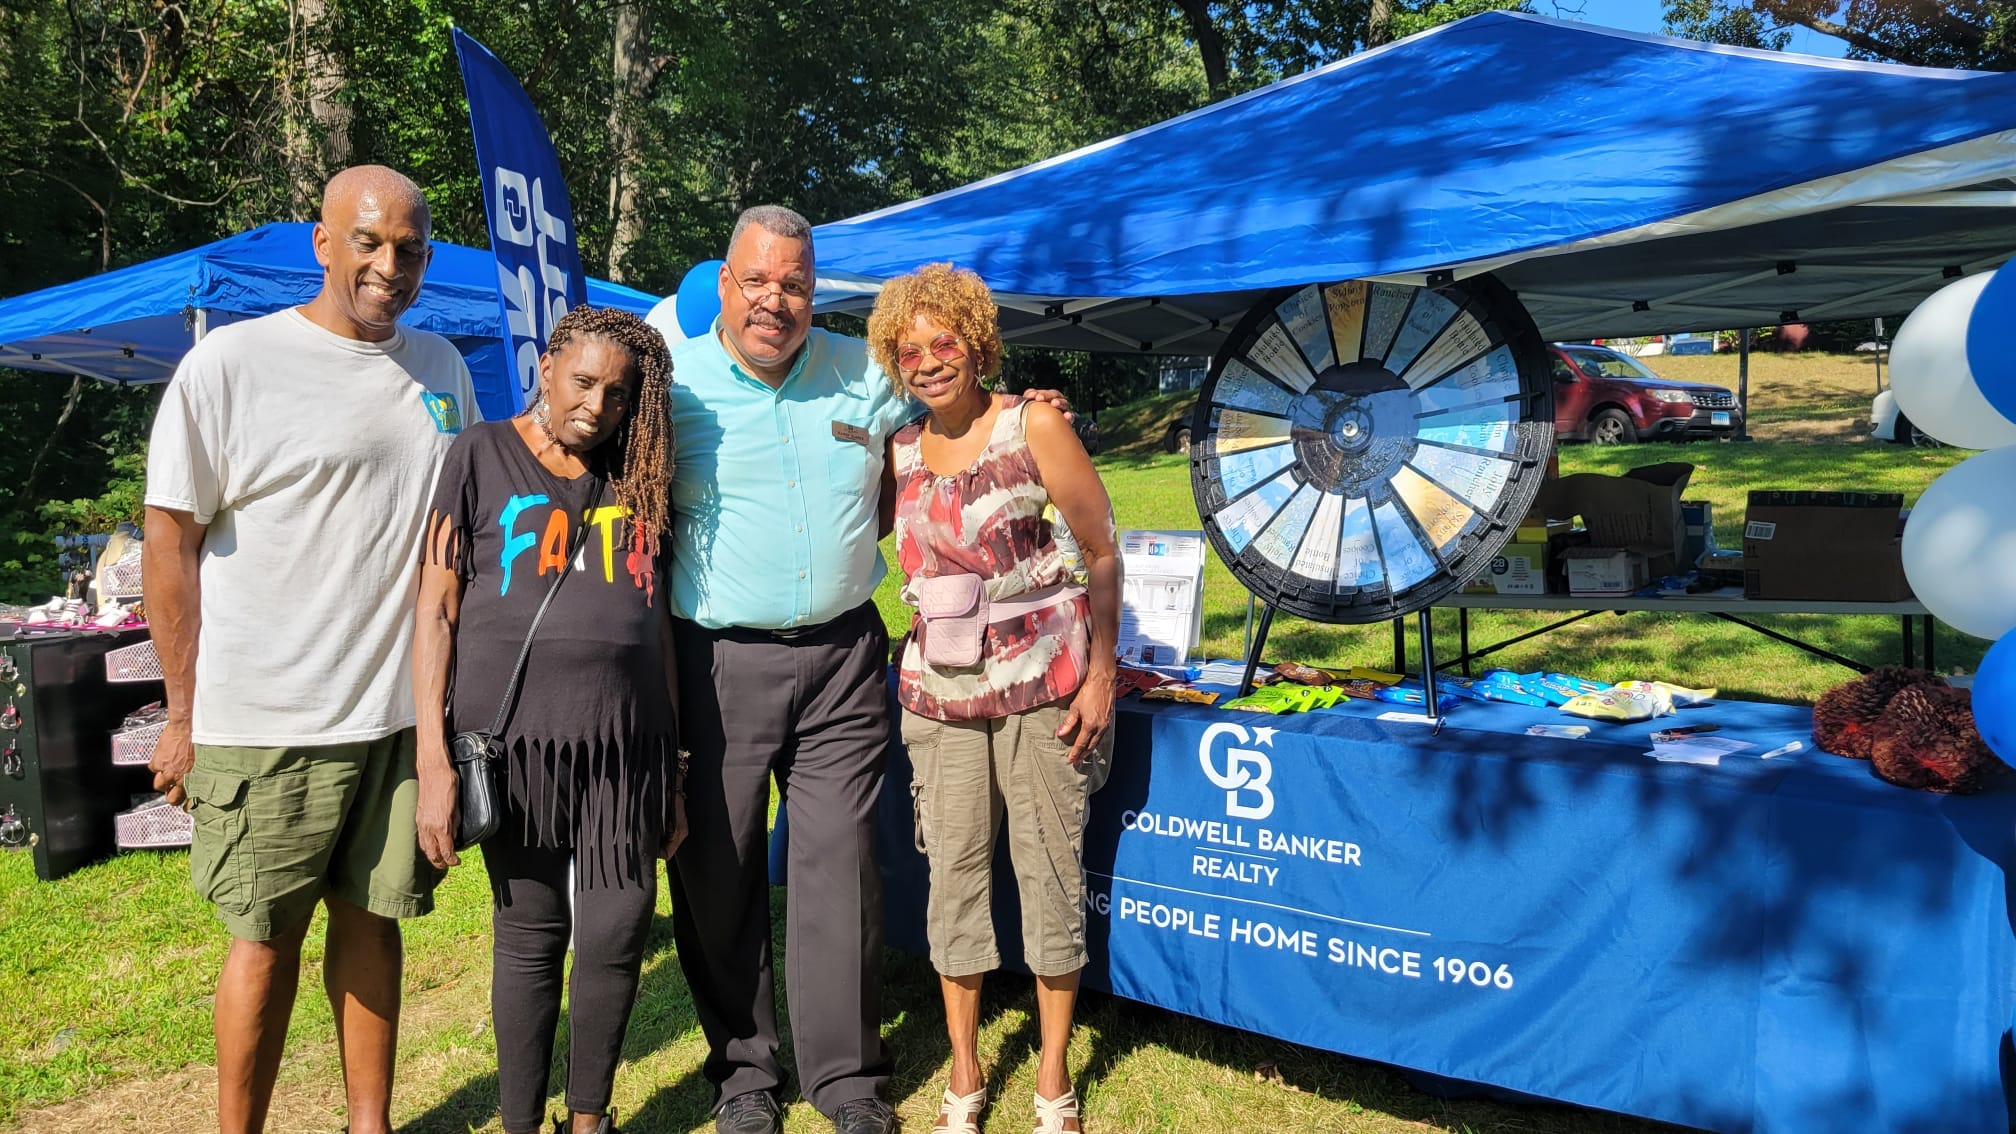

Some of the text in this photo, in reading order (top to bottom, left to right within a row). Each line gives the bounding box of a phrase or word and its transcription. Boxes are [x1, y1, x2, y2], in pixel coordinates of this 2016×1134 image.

[1373, 284, 1412, 299] Rancher
[1250, 326, 1282, 361] Insulated
[1448, 329, 1471, 356] Bottle
[1456, 315, 1486, 351] Insulated
[1261, 338, 1285, 363] Bottle
[1464, 457, 1491, 501] Rancher
[1480, 470, 1506, 498] Jolly
[1220, 513, 1244, 544] Choice
[1265, 526, 1295, 552] Rancher
[1262, 540, 1283, 560] Jolly
[1303, 547, 1330, 561] Bottle
[1342, 543, 1374, 555] Cookies
[1294, 558, 1332, 576] Insulated
[1343, 569, 1375, 581] Choice
[1121, 809, 1362, 866] COLDWELL BANKER
[1192, 855, 1280, 887] REALTY
[1120, 897, 1221, 939] PEOPLE
[1230, 918, 1318, 957] HOME
[1327, 937, 1421, 978] SINCE
[1432, 956, 1514, 990] 1906
